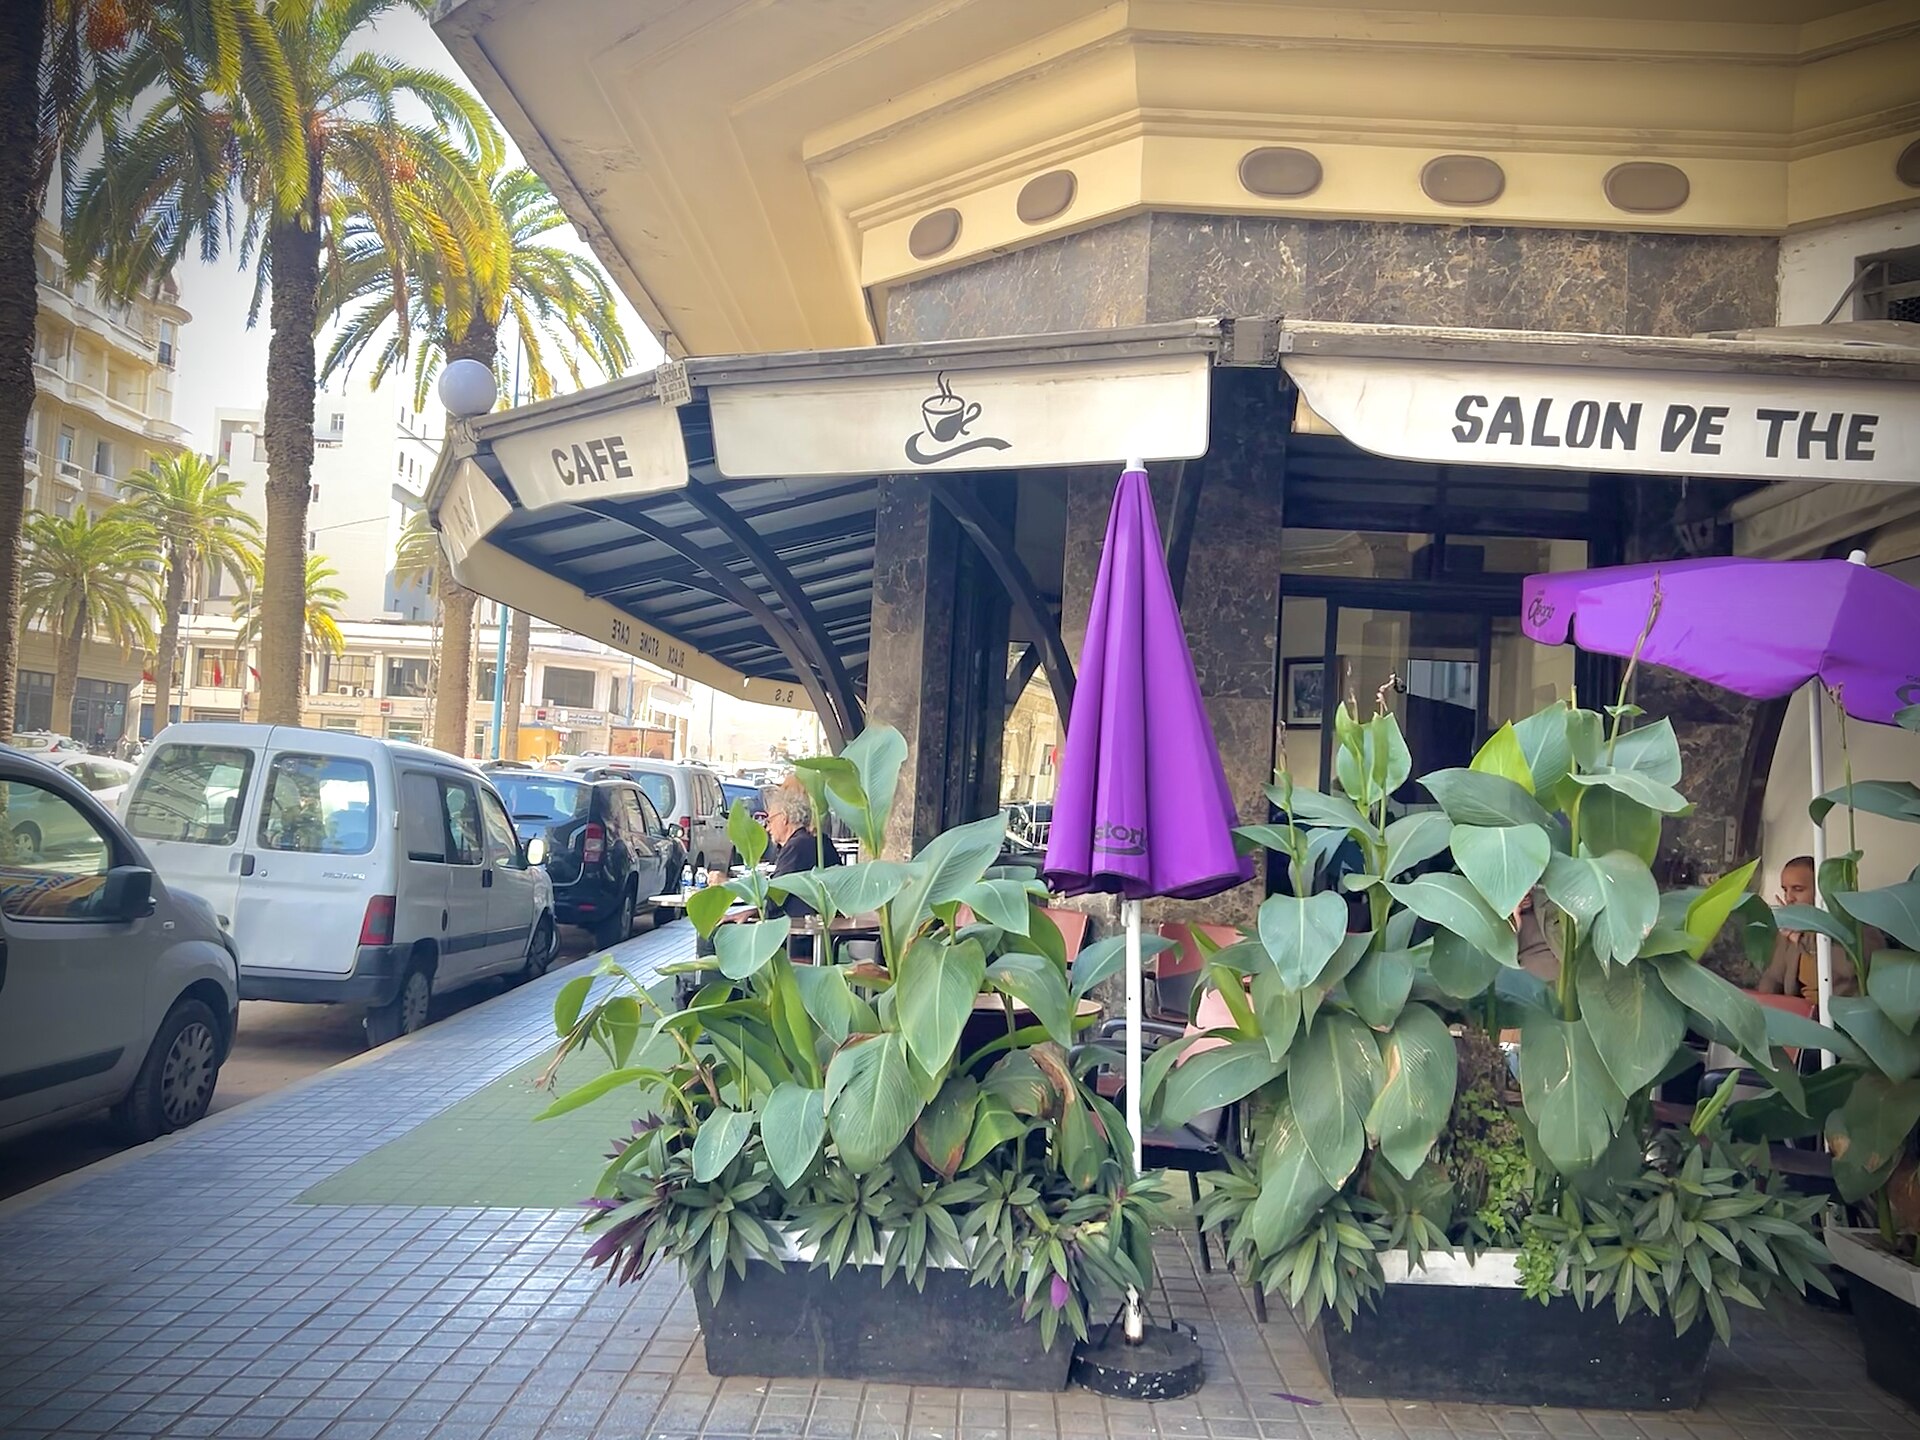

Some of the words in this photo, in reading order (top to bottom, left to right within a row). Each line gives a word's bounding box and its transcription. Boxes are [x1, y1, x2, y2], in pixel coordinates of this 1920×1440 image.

[1452, 394, 1643, 451] SALON
[1660, 404, 1730, 456] DE
[1756, 408, 1880, 461] THE
[551, 435, 634, 486] CAFE
